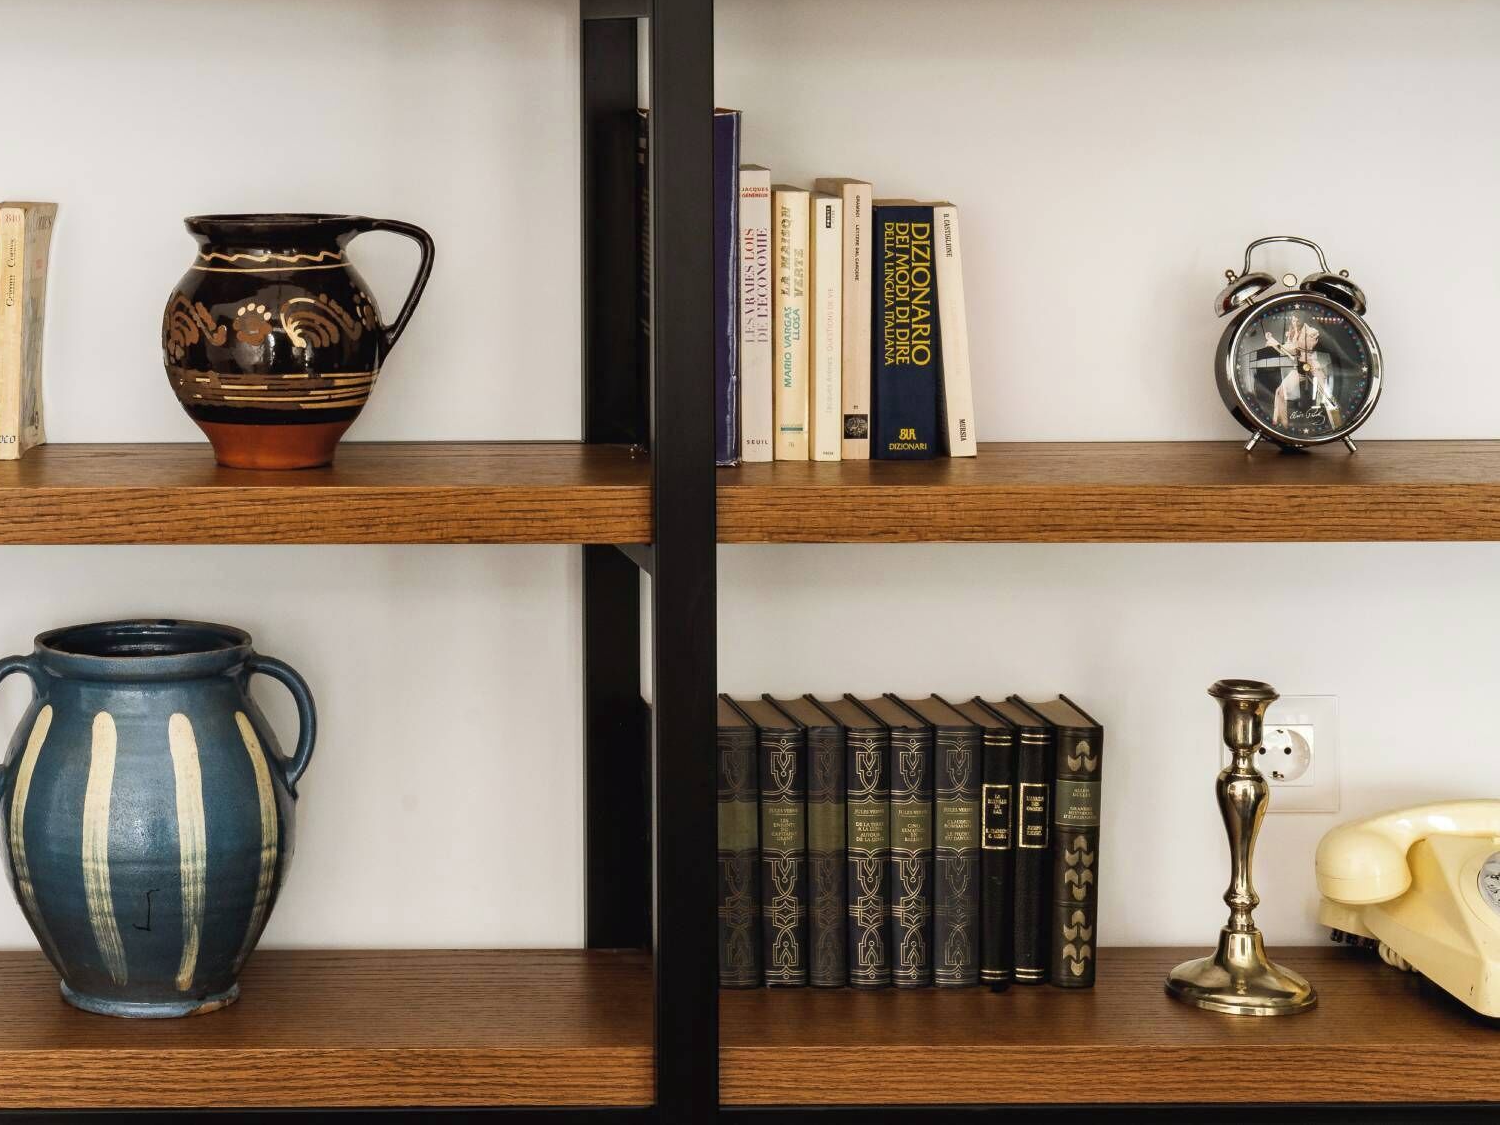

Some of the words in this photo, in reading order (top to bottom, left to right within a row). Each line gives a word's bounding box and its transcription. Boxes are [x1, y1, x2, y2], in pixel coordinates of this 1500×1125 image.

[745, 228, 754, 260] LOIS
[885, 223, 894, 259] DELLA
[896, 223, 909, 248] DEI
[745, 265, 755, 314] VRAIES
[755, 228, 768, 318] L'ÉCONOMIE
[885, 263, 894, 307] LINGUA
[896, 253, 909, 301] MODI
[911, 222, 930, 365] DIZIONARIO
[745, 318, 754, 343] LES
[784, 307, 792, 348] VARGAS
[792, 309, 800, 340] LLOSA
[896, 306, 909, 322] DI
[758, 322, 767, 343] DE
[884, 311, 894, 365] ITALIANA
[896, 328, 910, 365] DIRE
[784, 352, 792, 387] MARIO
